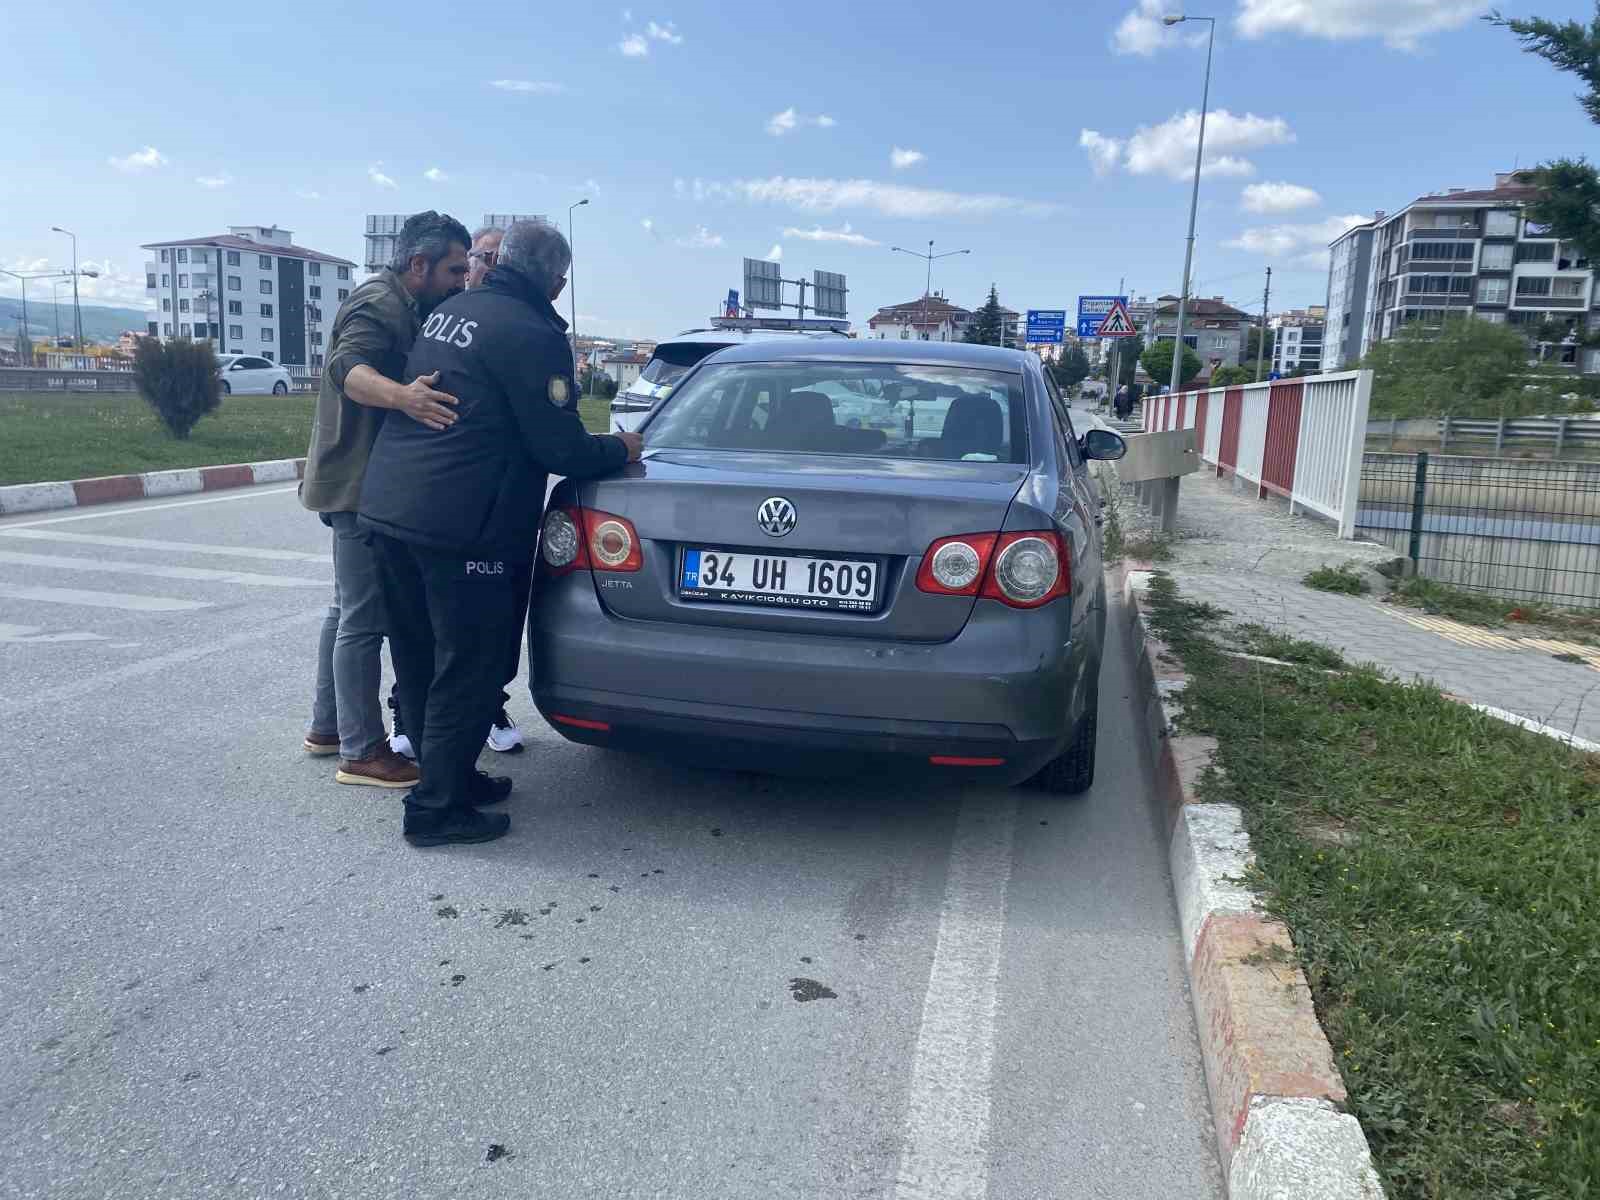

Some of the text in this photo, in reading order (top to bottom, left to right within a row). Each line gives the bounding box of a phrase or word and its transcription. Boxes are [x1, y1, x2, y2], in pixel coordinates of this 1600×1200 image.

[685, 571, 698, 581] TR
[703, 554, 872, 597] 34 UH 1609
[601, 579, 633, 589] JETTA
